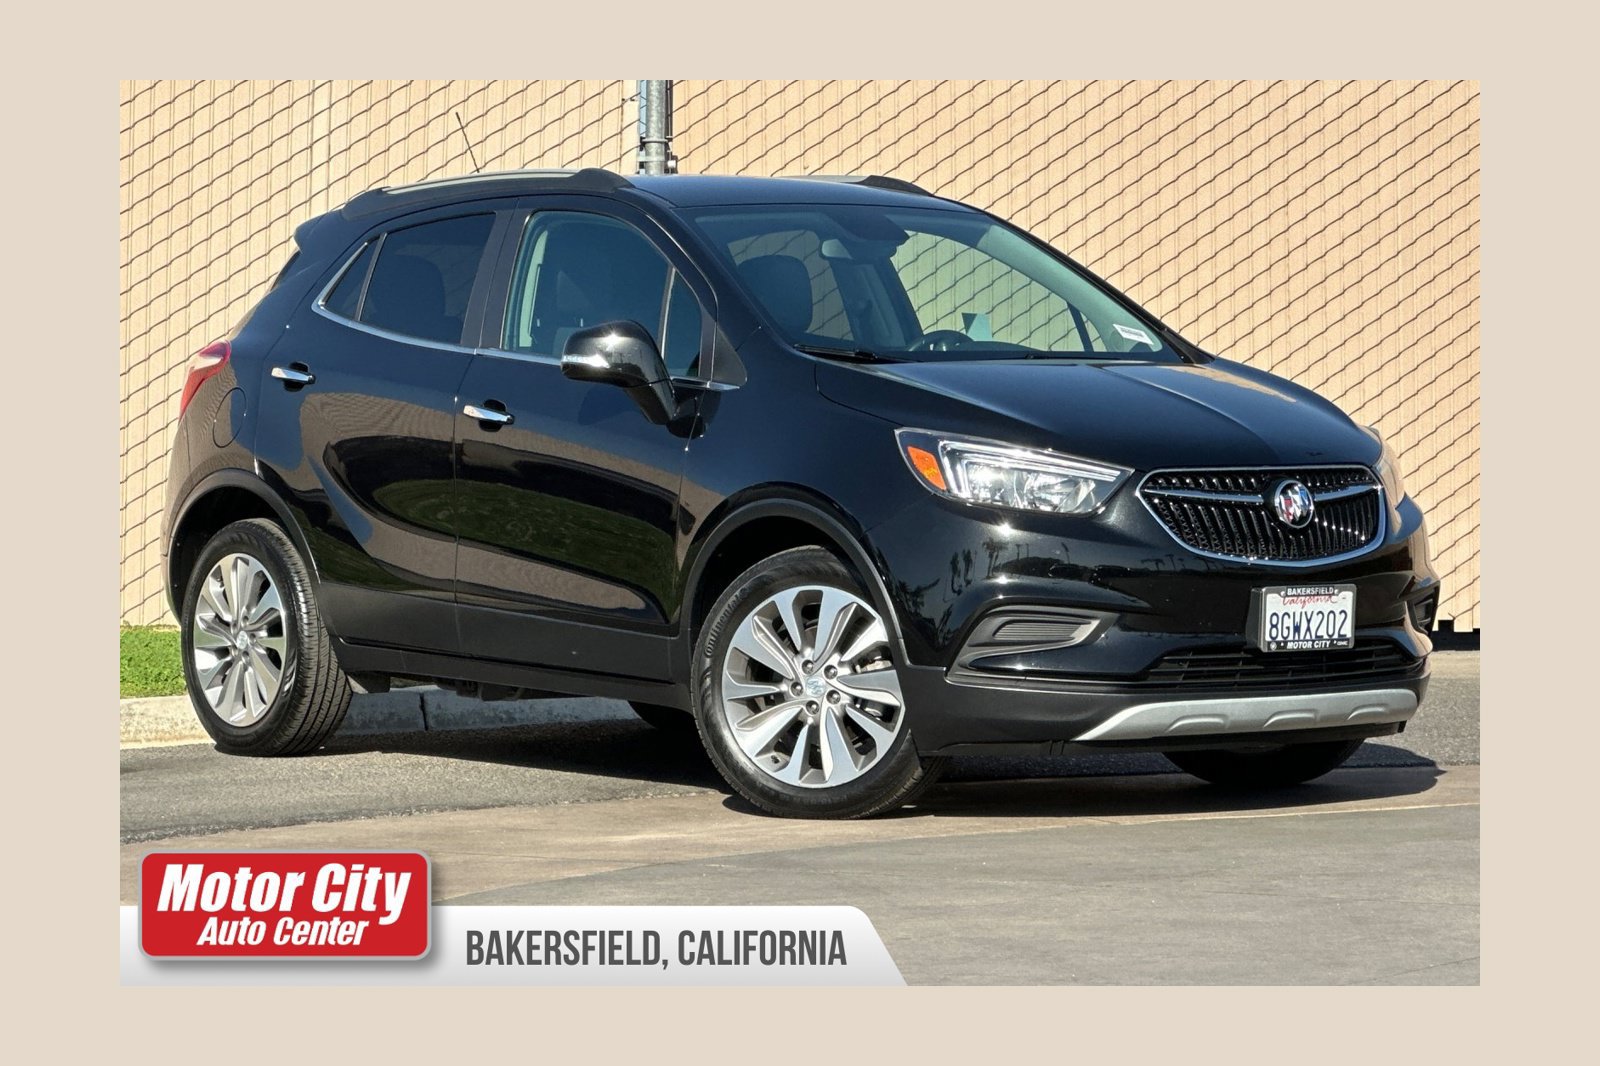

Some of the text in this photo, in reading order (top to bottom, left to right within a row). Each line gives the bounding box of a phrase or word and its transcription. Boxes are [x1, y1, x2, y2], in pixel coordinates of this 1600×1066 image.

[1287, 587, 1334, 595] BAKERSFIELD
[1268, 610, 1348, 641] 8GWX202
[1287, 641, 1312, 650] MOTOR
[1314, 640, 1331, 648] CITY
